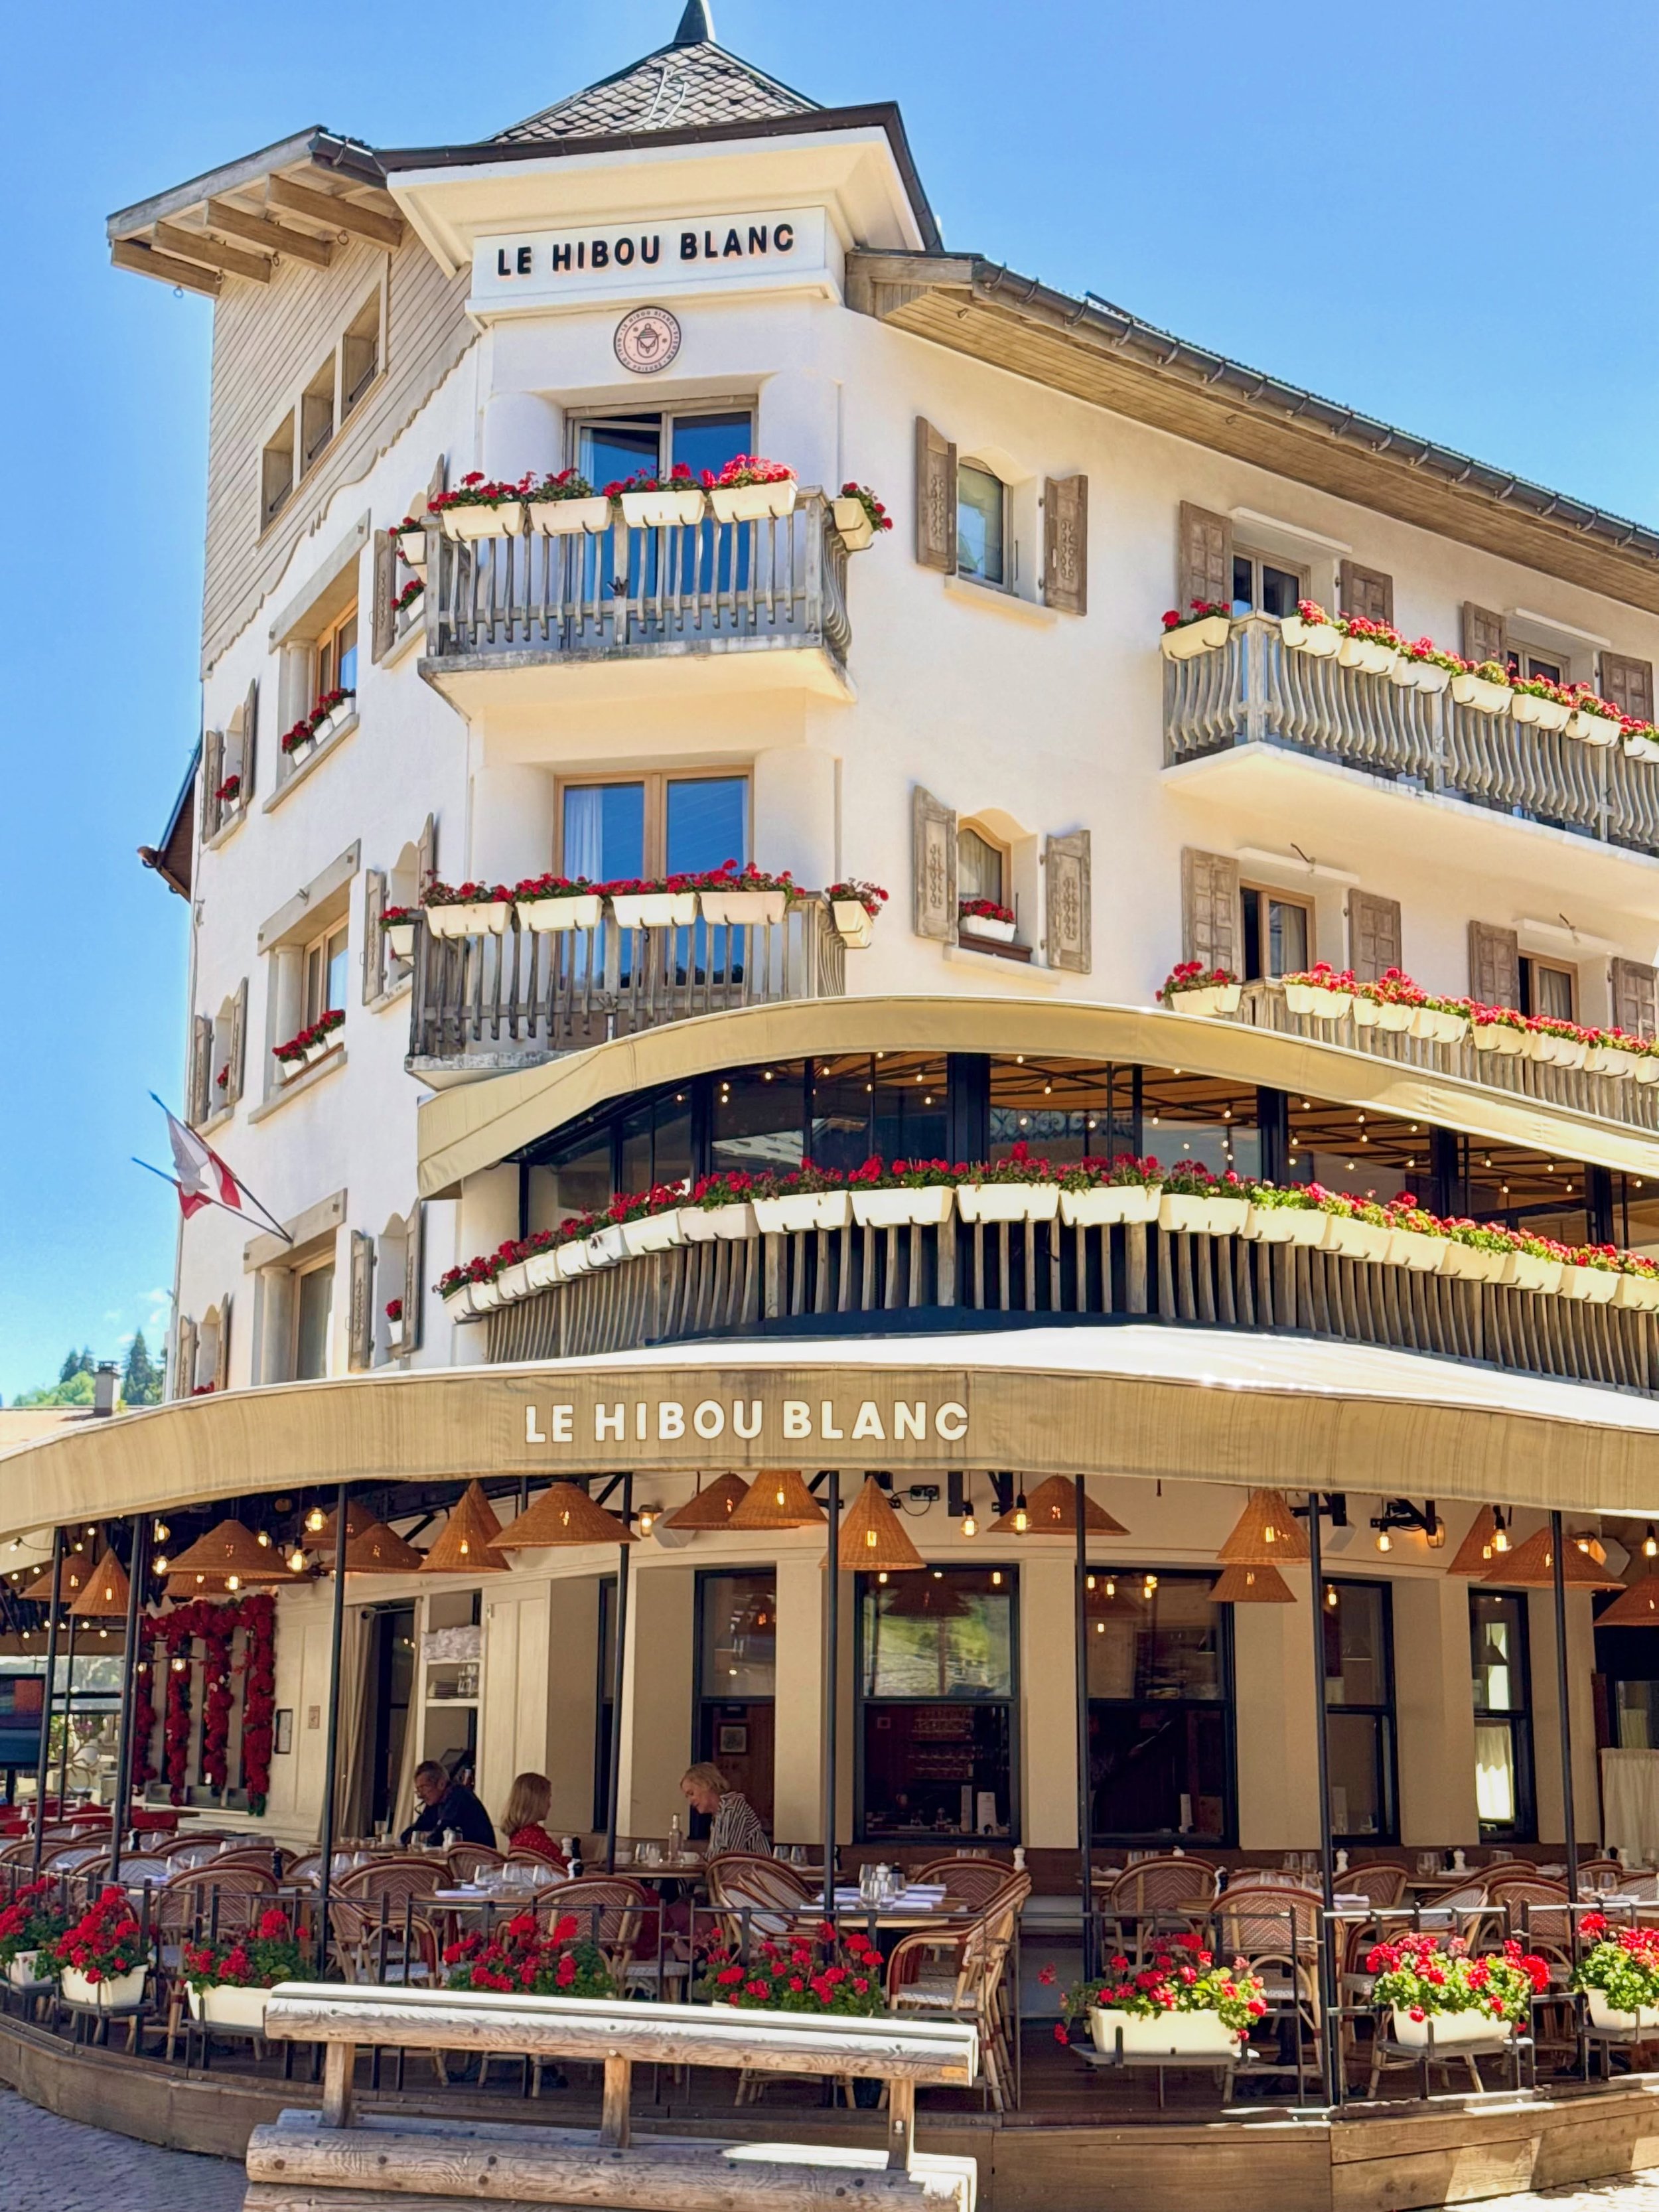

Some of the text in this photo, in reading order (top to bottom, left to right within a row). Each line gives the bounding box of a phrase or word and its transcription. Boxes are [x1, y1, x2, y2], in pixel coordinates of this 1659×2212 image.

[497, 224, 794, 276] LE HIBOU BLANC
[628, 311, 651, 323] HIBOU
[654, 311, 674, 326] BLANC
[526, 1400, 969, 1443] LE HIBOU BLANC
